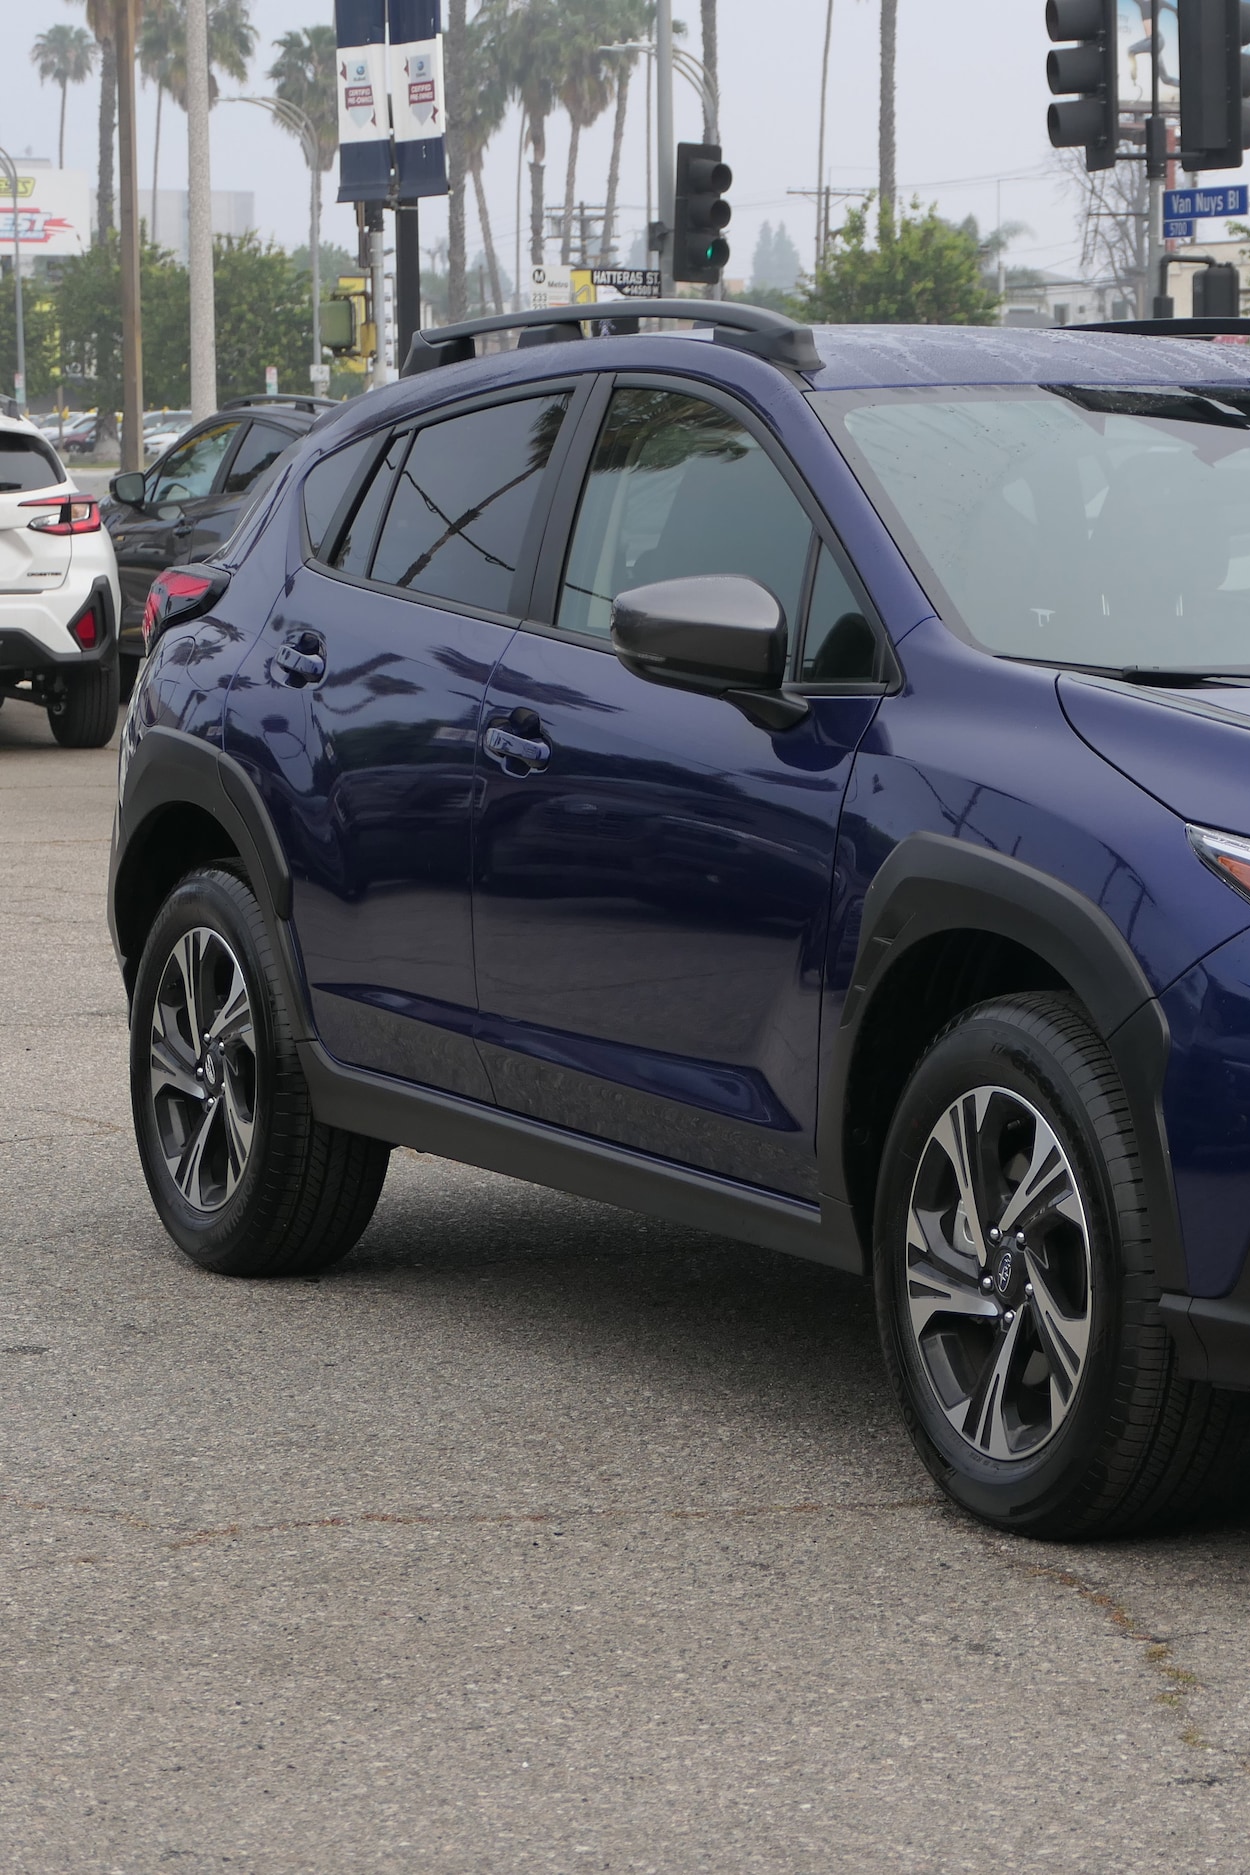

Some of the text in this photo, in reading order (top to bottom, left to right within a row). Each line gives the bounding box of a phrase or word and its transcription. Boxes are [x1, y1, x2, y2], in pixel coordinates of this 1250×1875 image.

[1171, 190, 1240, 216] Van Nuys Bl
[1169, 221, 1188, 236] 5700
[547, 280, 569, 289] Metro
[593, 270, 643, 285] HATTERAS
